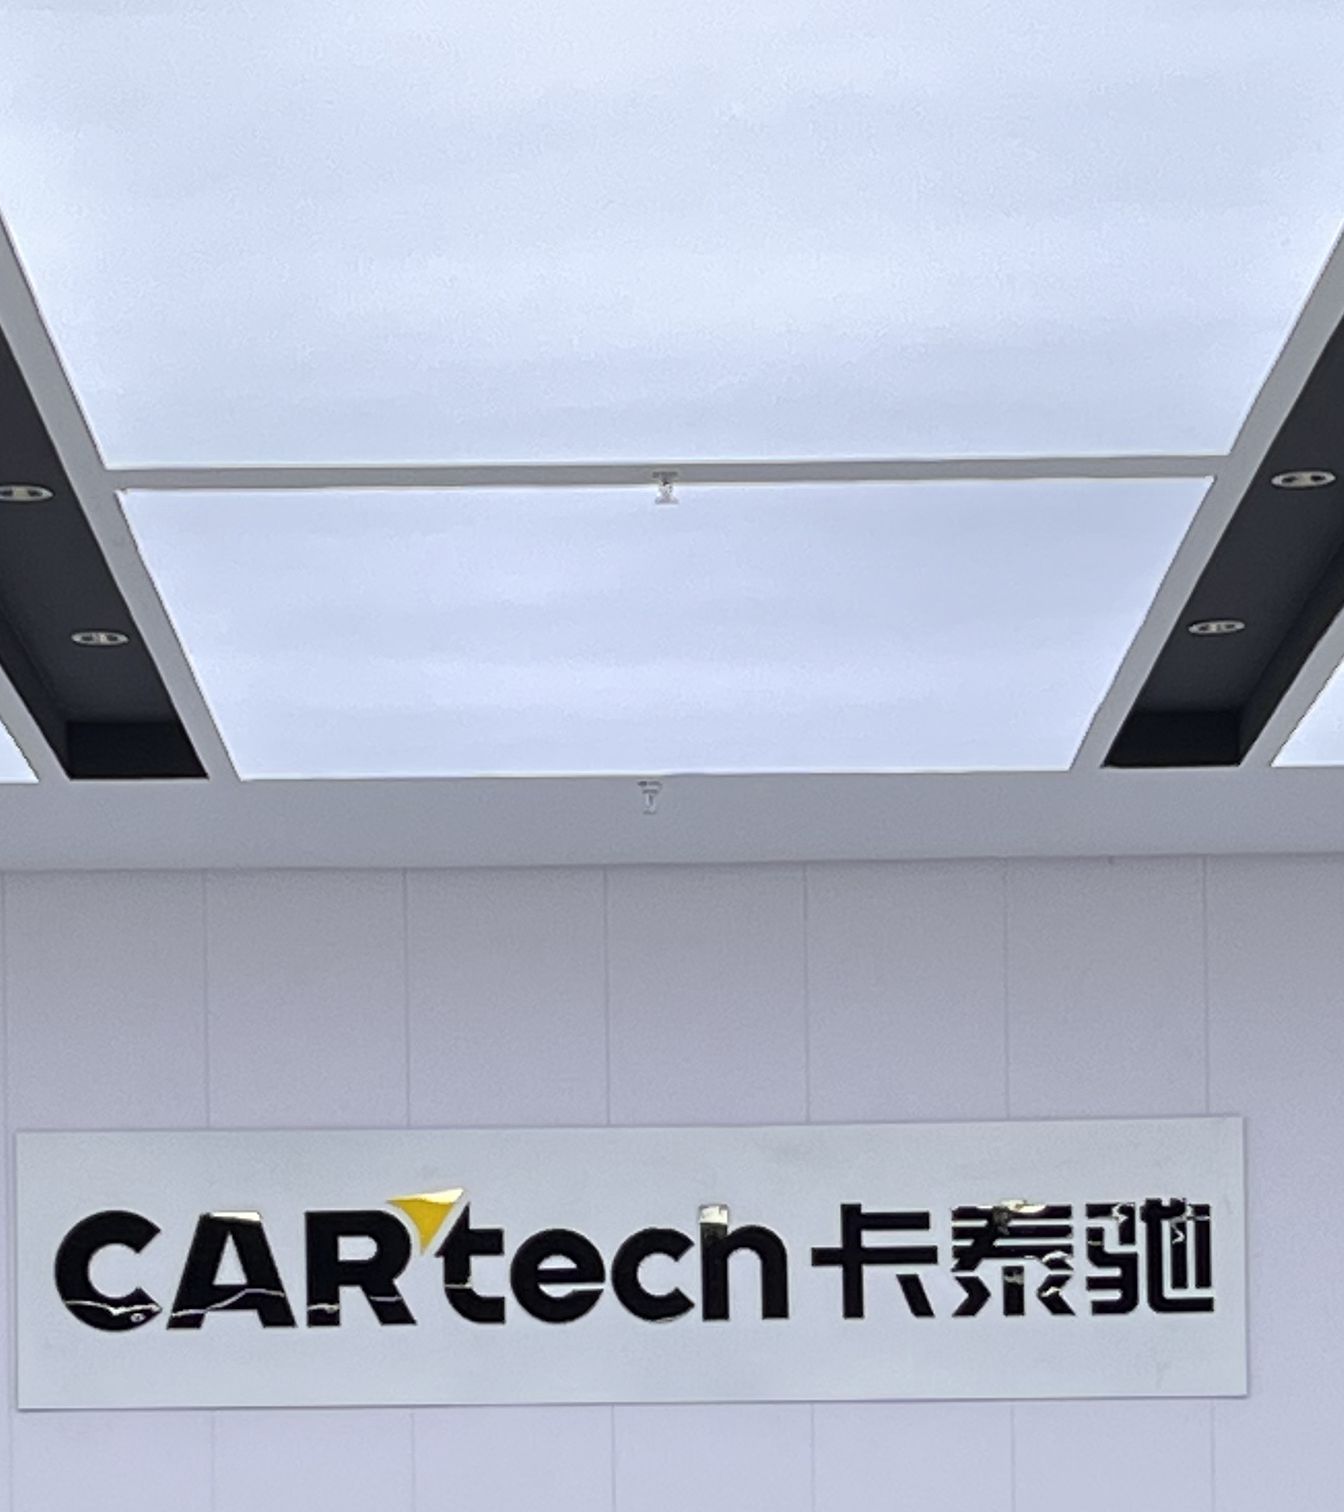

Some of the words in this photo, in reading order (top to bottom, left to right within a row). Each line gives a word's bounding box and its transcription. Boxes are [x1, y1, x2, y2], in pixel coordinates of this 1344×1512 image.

[54, 1190, 790, 1331] CARtech
[810, 1198, 1216, 1320] 卡泰驰
